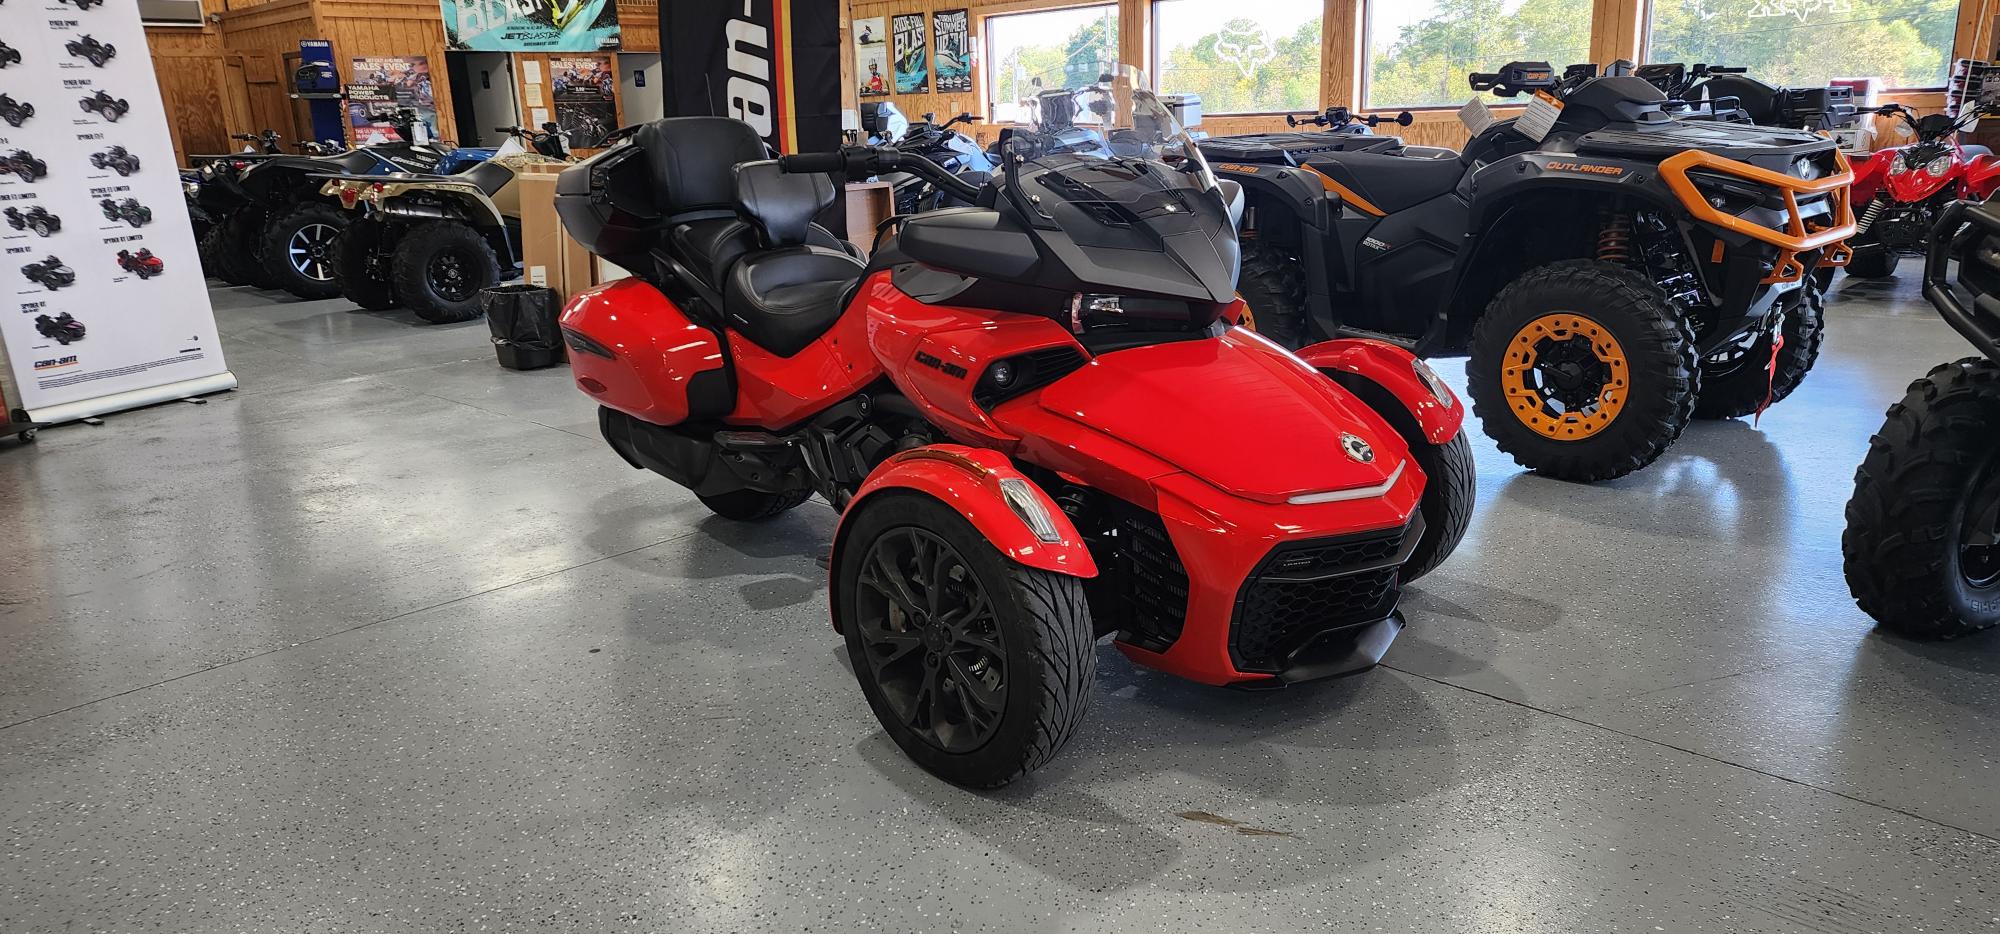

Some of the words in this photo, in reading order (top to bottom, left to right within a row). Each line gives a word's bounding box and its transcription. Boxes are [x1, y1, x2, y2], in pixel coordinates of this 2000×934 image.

[893, 16, 910, 33] RIDE
[909, 15, 924, 29] FULL
[933, 18, 967, 35] SUMMER
[894, 28, 925, 62] BLAST
[936, 33, 949, 54] UP
[353, 62, 381, 70] SALES
[383, 62, 411, 70] EVENT
[1546, 161, 1623, 175] OUTLANDER
[1362, 240, 1380, 250] ROTAX
[34, 355, 77, 368] can-am
[914, 350, 968, 380] can-am
